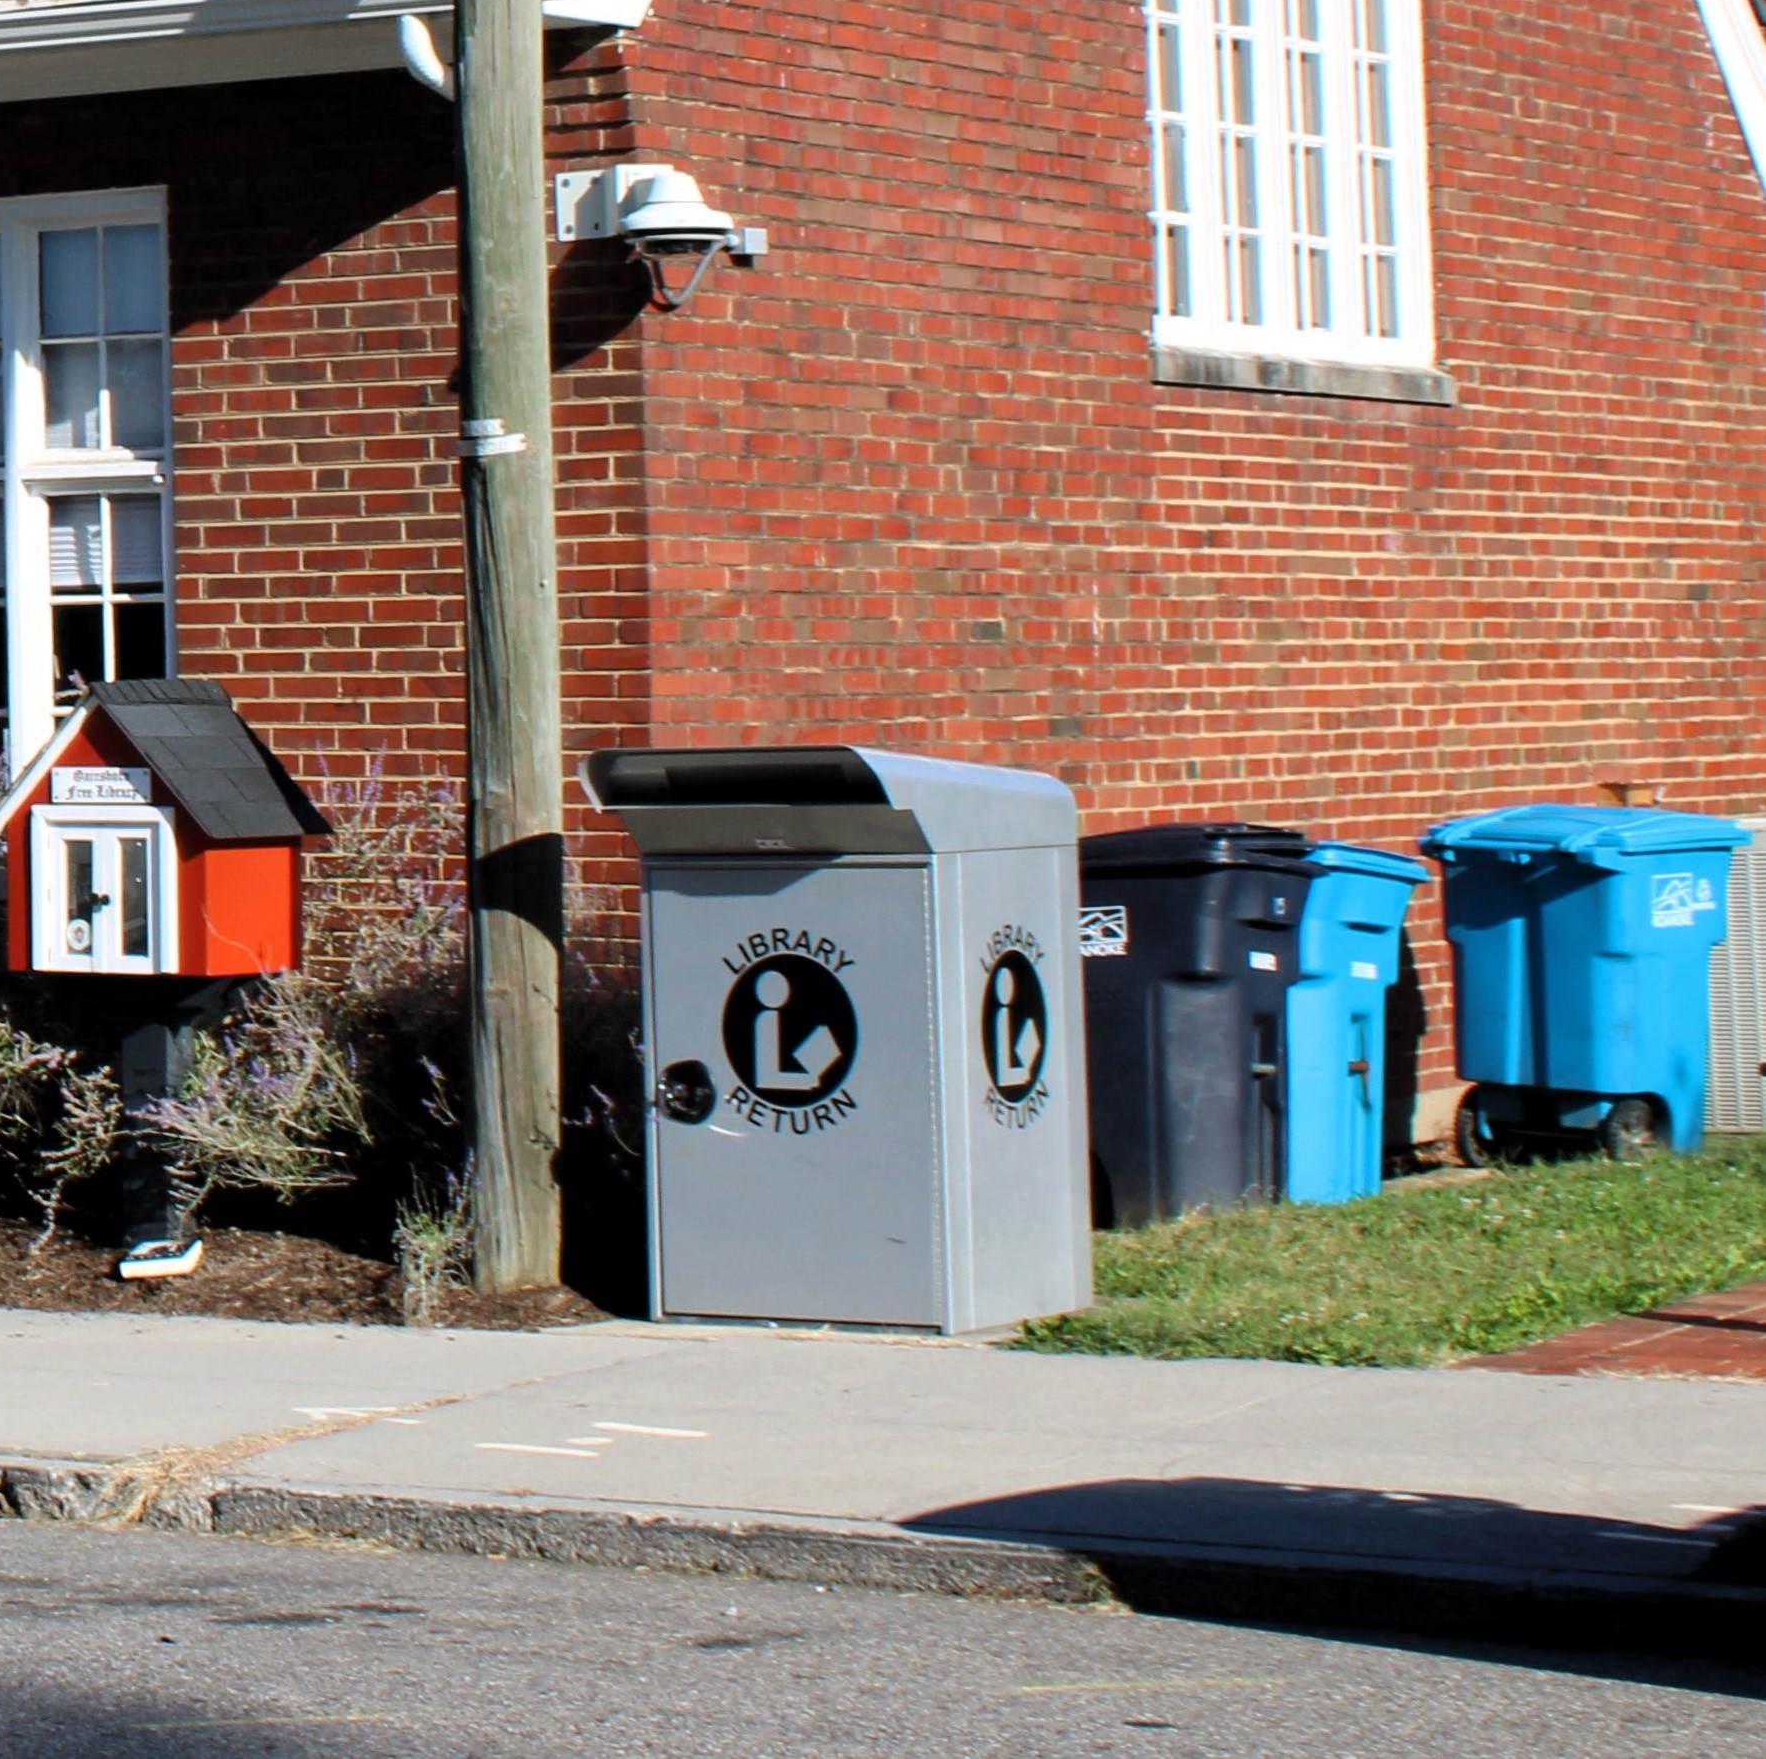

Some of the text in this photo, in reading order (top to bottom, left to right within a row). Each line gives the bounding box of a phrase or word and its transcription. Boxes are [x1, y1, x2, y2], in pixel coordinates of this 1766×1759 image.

[65, 784, 138, 801] Free Library
[722, 928, 855, 975] LIBRARY
[979, 924, 1045, 974] LIBRARY
[725, 1084, 858, 1136] RETURN
[983, 1079, 1050, 1130] RETURN
